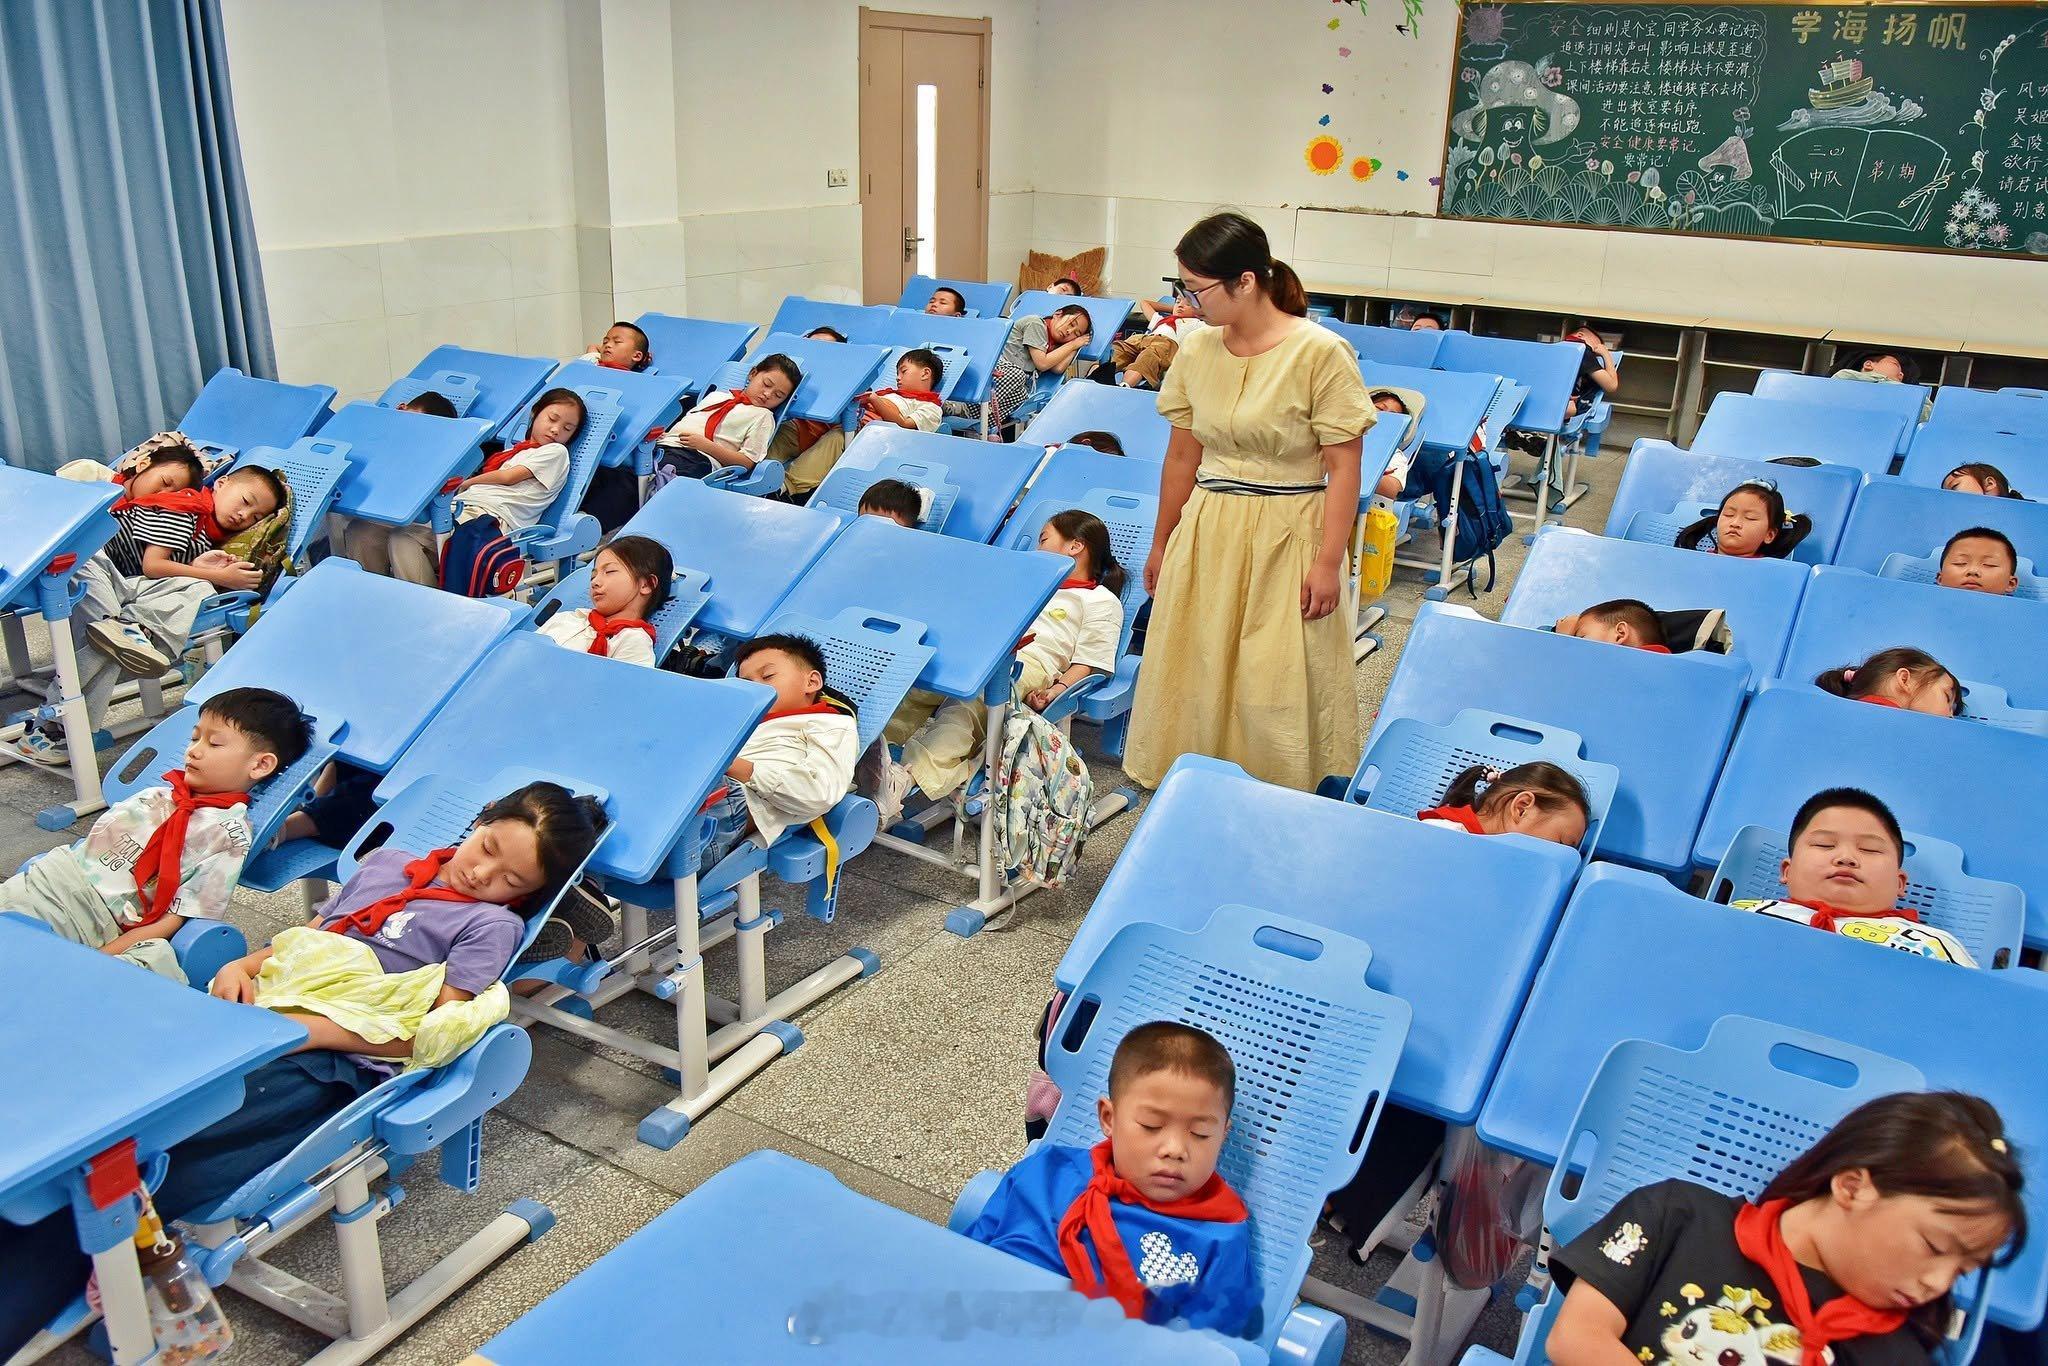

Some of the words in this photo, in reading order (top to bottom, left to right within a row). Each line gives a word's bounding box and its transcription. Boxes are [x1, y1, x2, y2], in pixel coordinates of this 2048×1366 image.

[1791, 10, 1968, 51] 学海扬帆
[2008, 132, 2043, 151] 金陵
[2002, 153, 2048, 173] 欲行
[1810, 168, 1843, 188] 中队
[2012, 200, 2046, 220] 别意
